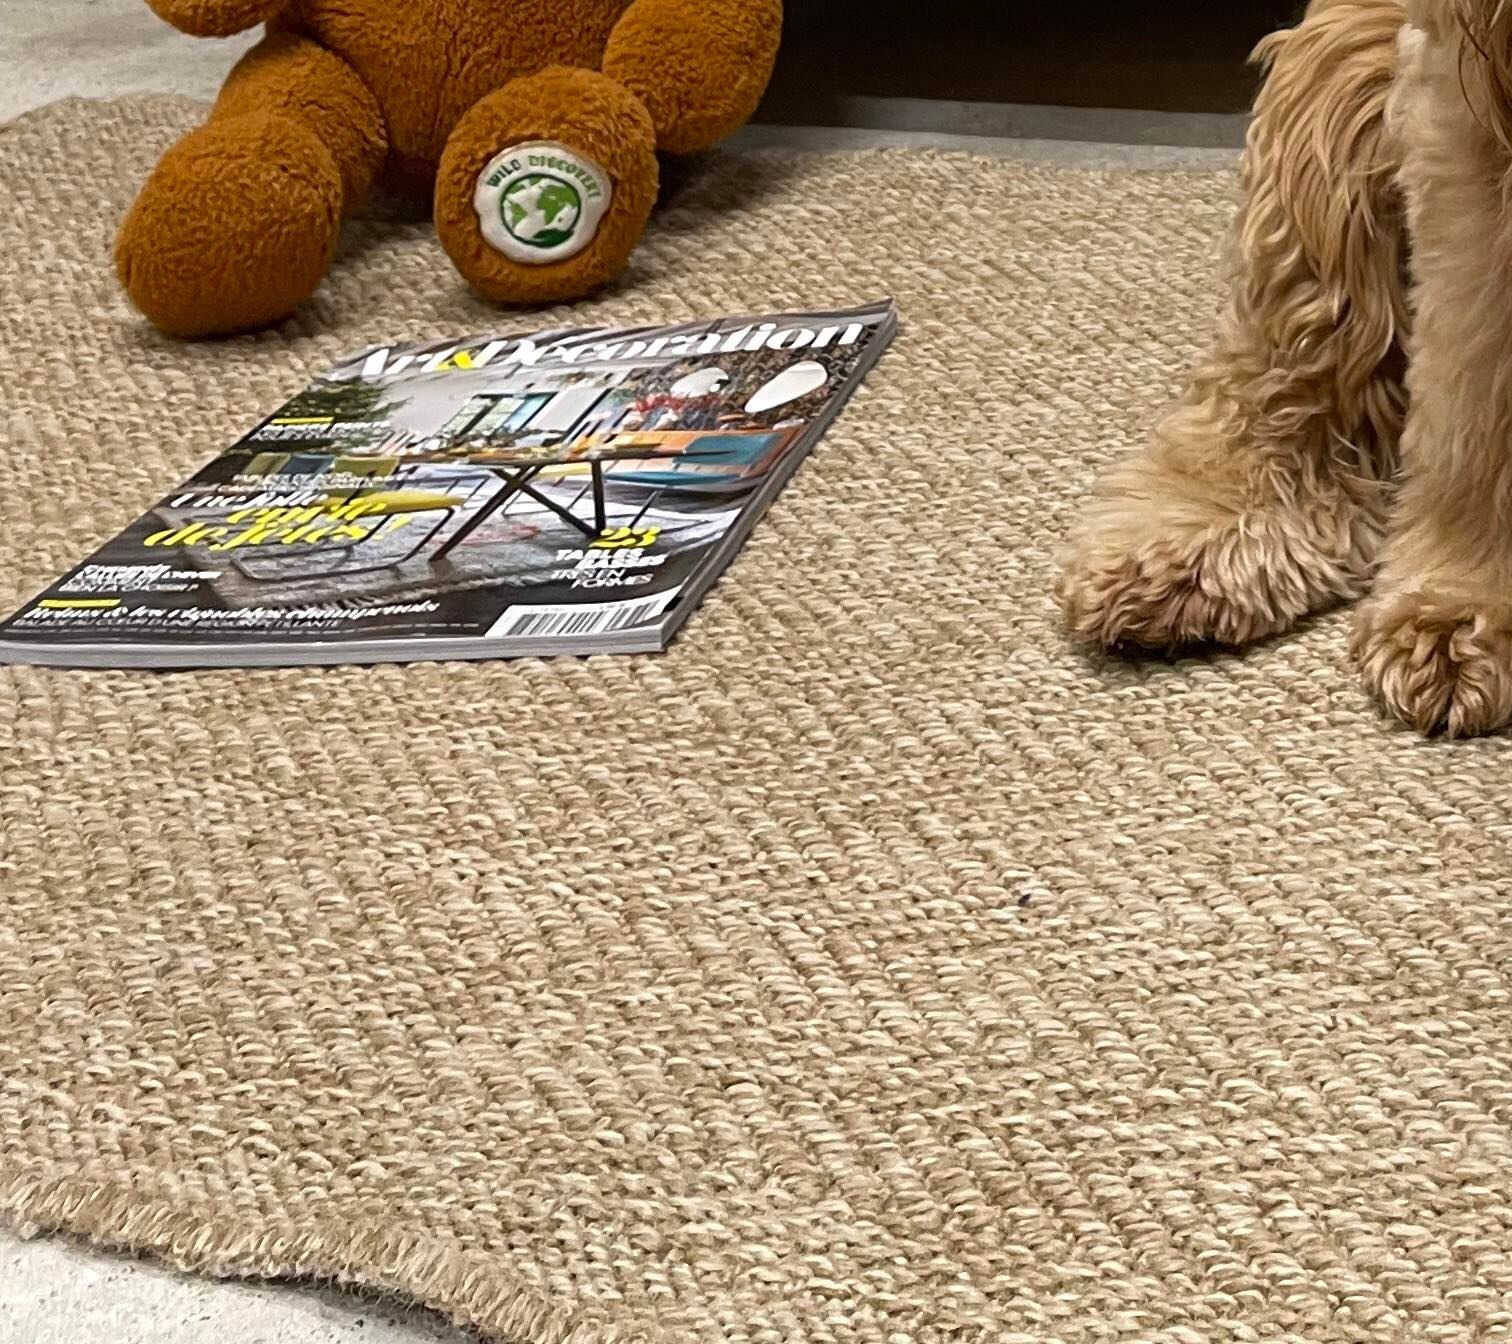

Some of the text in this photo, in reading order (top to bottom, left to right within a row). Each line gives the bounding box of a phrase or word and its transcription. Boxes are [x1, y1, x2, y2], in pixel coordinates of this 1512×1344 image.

[486, 158, 523, 188] WILD
[143, 522, 229, 546] de
[587, 526, 662, 548] 23
